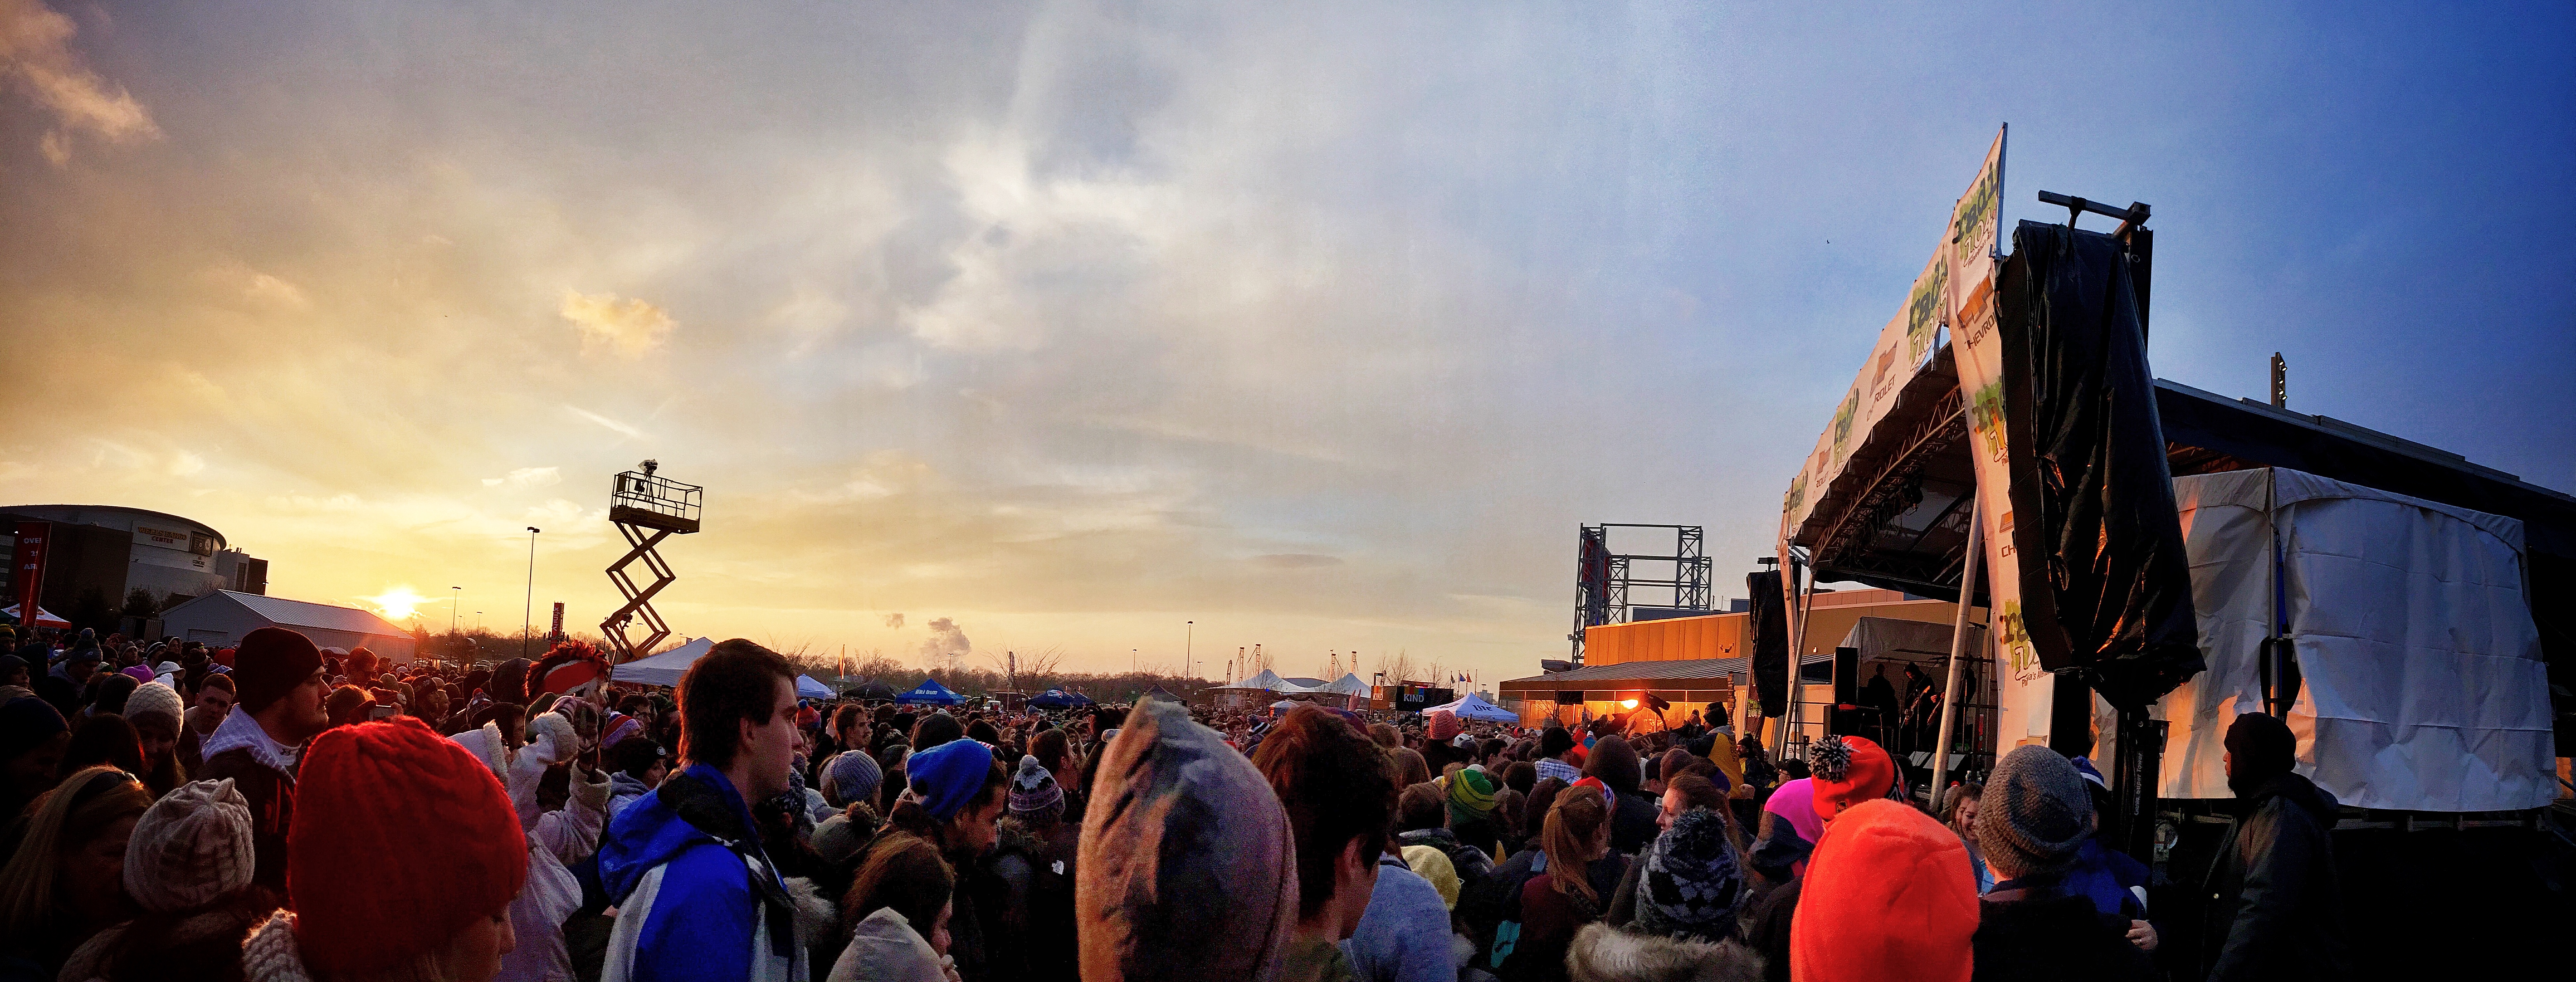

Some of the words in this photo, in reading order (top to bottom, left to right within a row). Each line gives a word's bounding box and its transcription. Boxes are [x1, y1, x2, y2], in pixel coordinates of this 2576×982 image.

[1952, 160, 1999, 244] radi
[138, 527, 164, 536] WELLS
[165, 531, 187, 540] FARGO
